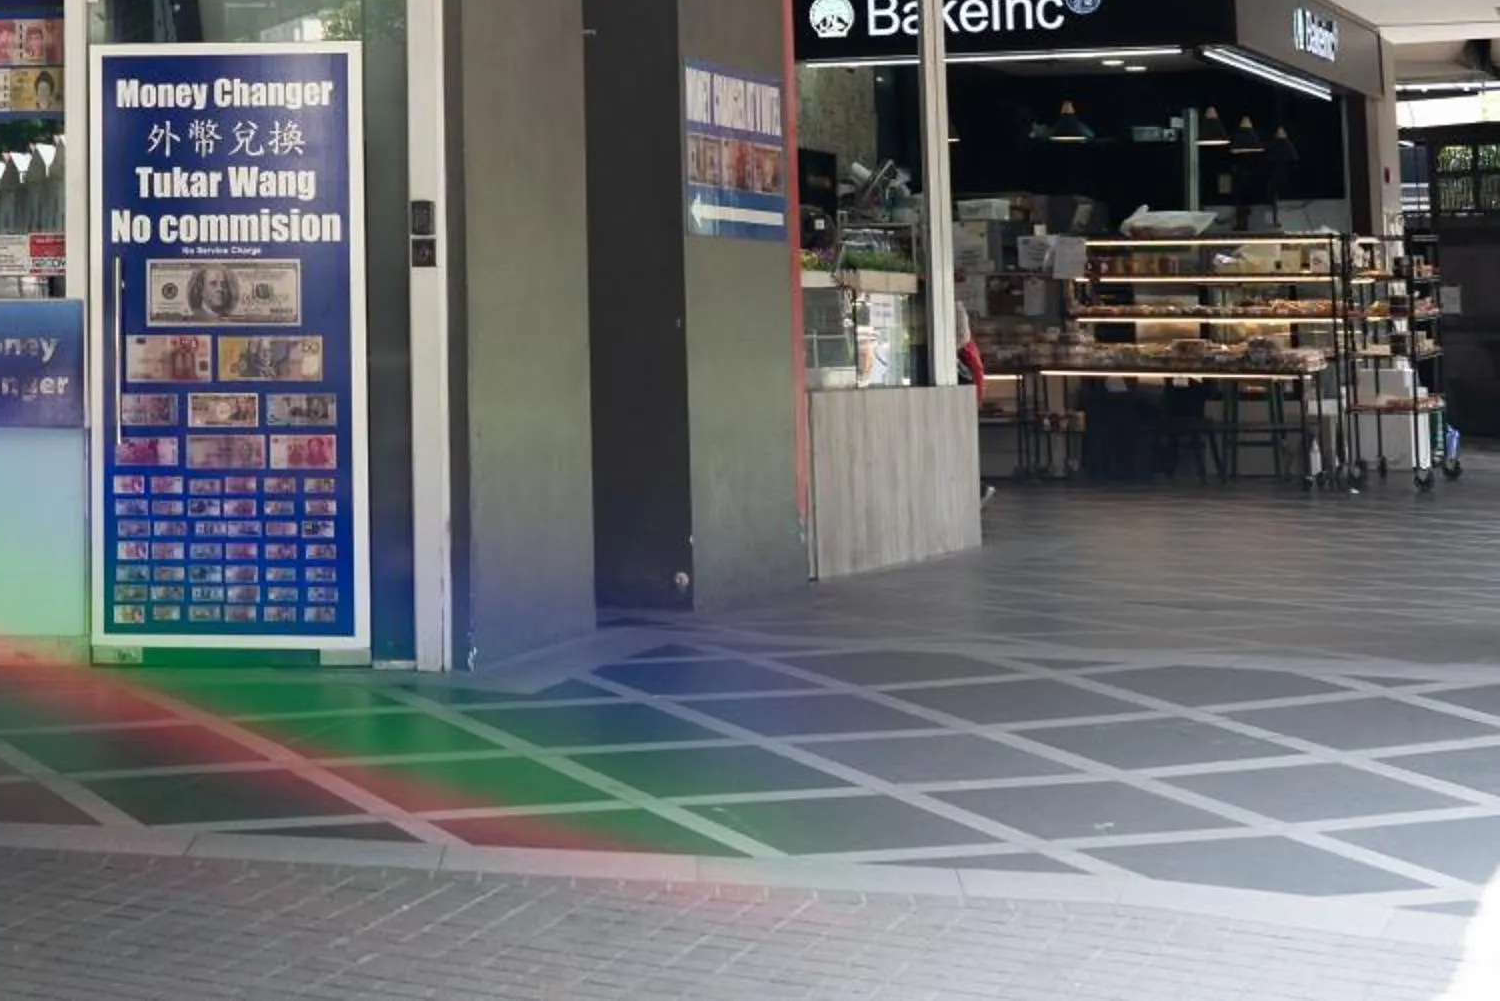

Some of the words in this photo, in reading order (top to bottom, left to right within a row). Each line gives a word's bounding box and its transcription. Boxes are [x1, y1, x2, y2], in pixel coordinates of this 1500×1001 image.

[116, 78, 208, 110] Money
[213, 77, 333, 110] Changer
[135, 166, 223, 199] Tukar
[228, 165, 317, 201] Wang
[111, 209, 151, 244] No
[159, 208, 342, 244] commision
[197, 246, 229, 254] Service
[231, 246, 262, 256] Charge
